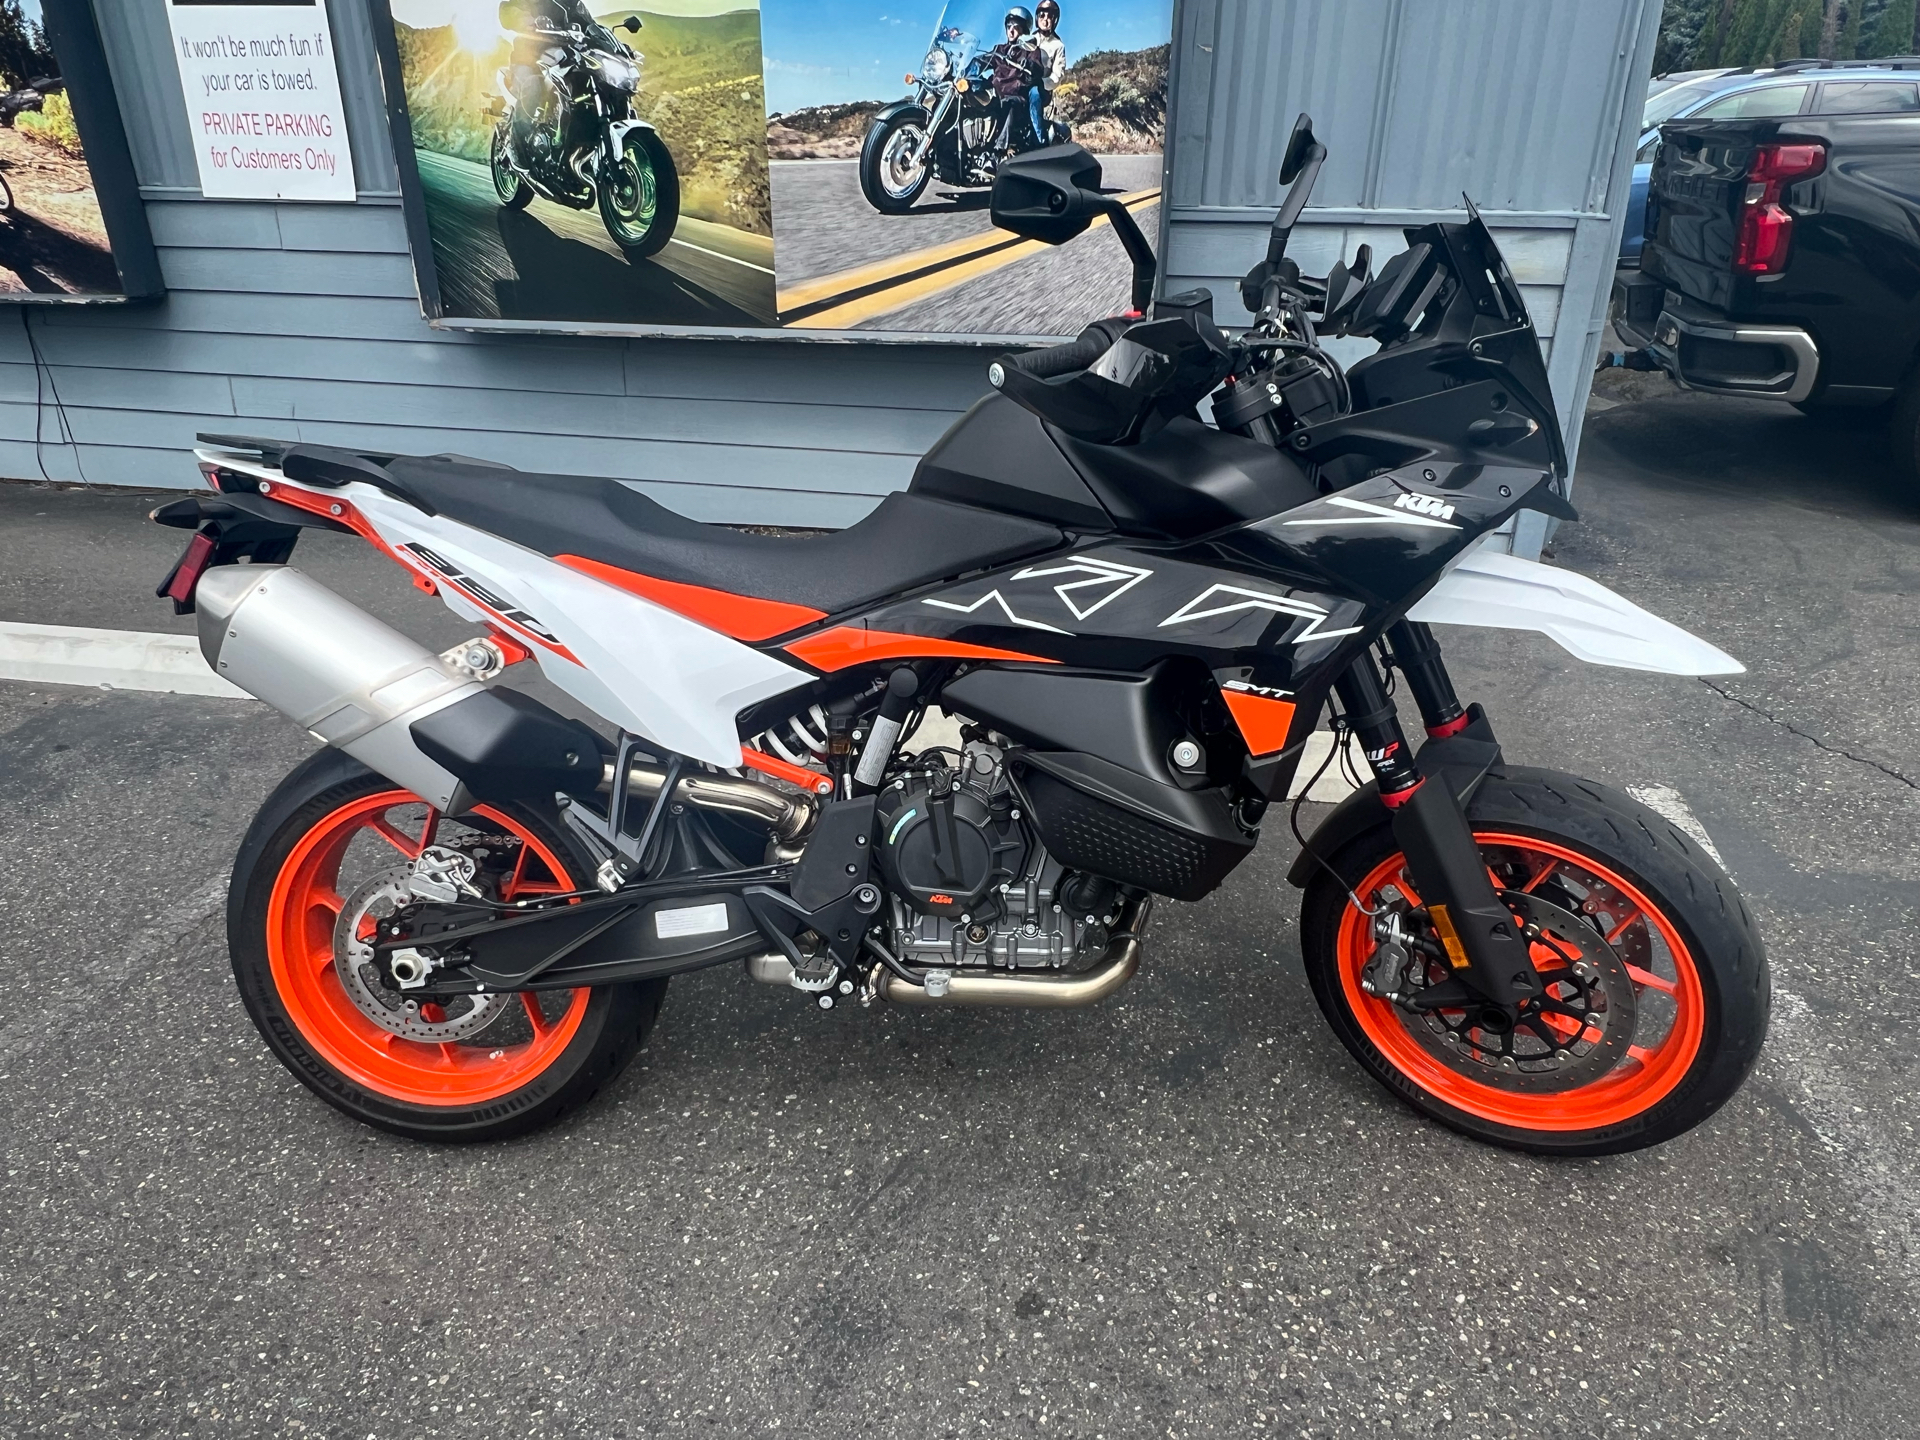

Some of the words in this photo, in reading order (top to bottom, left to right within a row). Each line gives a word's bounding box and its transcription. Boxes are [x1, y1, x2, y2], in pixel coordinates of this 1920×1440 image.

[180, 36, 192, 58] It
[192, 35, 228, 58] won't
[228, 35, 246, 58] be
[250, 34, 286, 57] much
[289, 33, 311, 56] fun
[314, 33, 325, 57] if
[202, 73, 230, 97] your
[234, 73, 254, 91] car
[256, 68, 270, 91] is
[271, 67, 318, 91] towed.
[202, 112, 263, 136] PRIVATE
[264, 113, 333, 137] PARKING
[211, 146, 228, 168] for
[231, 146, 302, 170] Customers
[304, 147, 336, 177] Only
[1393, 492, 1455, 520] KTM
[404, 542, 560, 643] 890
[1222, 680, 1295, 698] SMT
[1366, 741, 1399, 761] WP
[929, 894, 953, 904] KTM
[273, 1020, 338, 1089] MICHELIN
